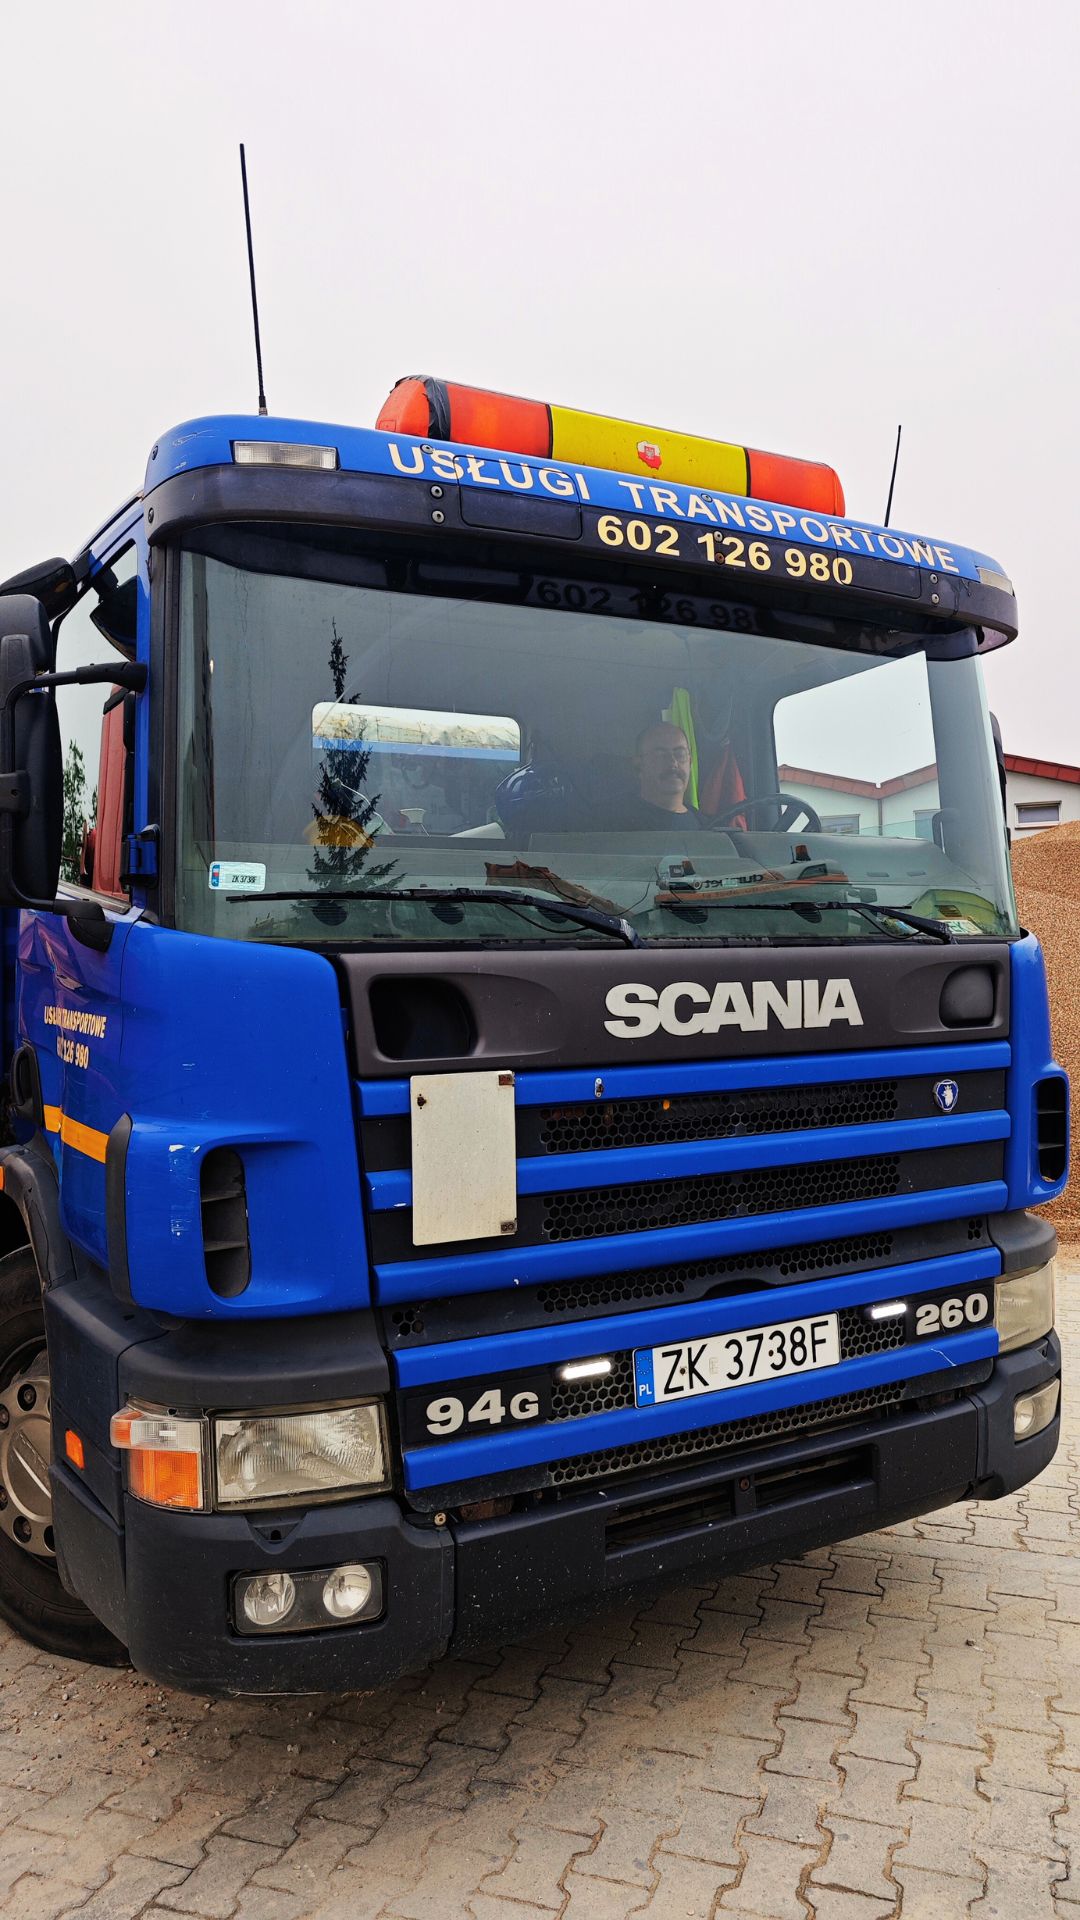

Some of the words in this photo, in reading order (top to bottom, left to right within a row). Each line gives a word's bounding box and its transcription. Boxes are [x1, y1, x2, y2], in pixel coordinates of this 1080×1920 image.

[387, 443, 591, 500] USŁUGI
[618, 480, 960, 574] TRANSPORTOWE
[597, 515, 680, 557] 602
[697, 532, 771, 571] 126
[784, 548, 854, 586] 980
[604, 978, 864, 1039] SCANIA
[75, 1043, 89, 1069] 980
[915, 1292, 989, 1335] 260
[661, 1343, 709, 1394] ZK
[725, 1320, 829, 1381] 3738F
[639, 1384, 653, 1396] PL
